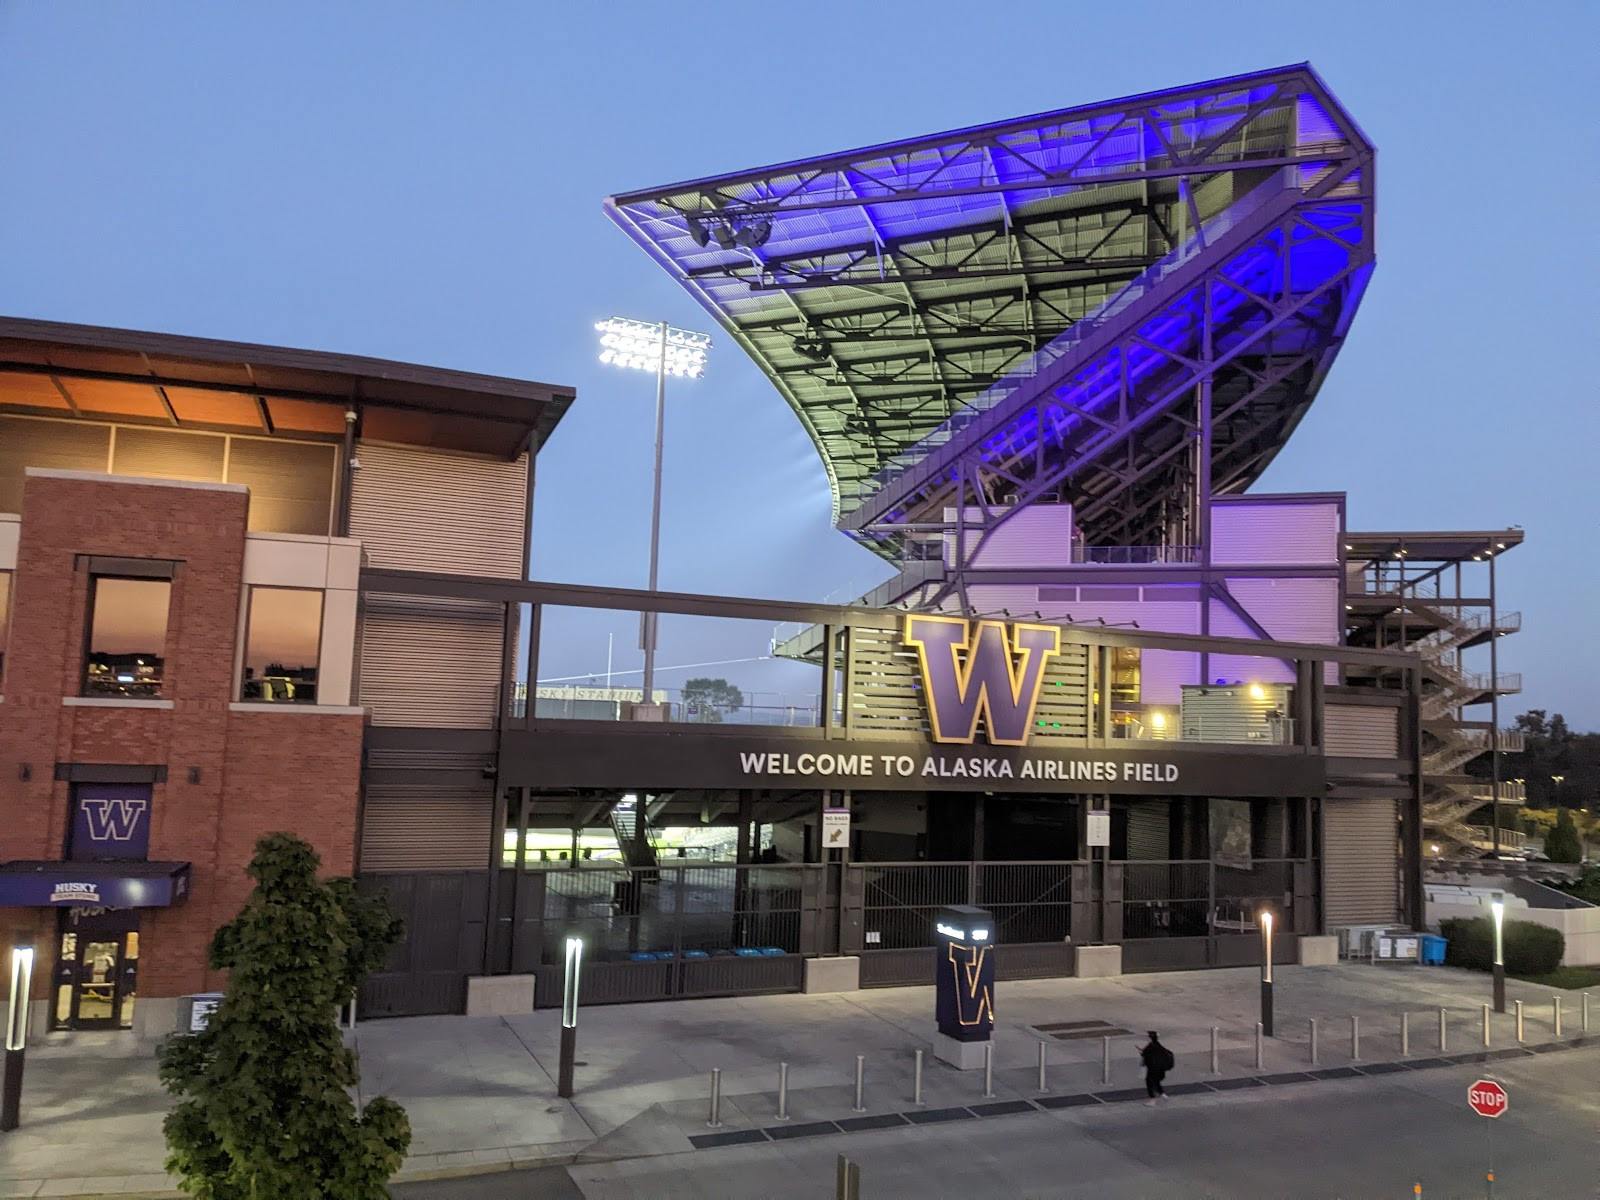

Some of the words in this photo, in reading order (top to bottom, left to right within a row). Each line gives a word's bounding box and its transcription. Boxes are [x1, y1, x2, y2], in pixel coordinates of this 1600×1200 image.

[904, 614, 1061, 747] W
[539, 689, 567, 699] SKY
[740, 752, 874, 776] WELCOME
[880, 755, 915, 777] TO
[921, 757, 1014, 779] ALASKA
[1020, 759, 1118, 782] AIRLINES
[1123, 762, 1179, 783] FIELD
[81, 799, 147, 840] W
[55, 882, 98, 894] HUSKY
[1471, 1090, 1505, 1107] STOP
